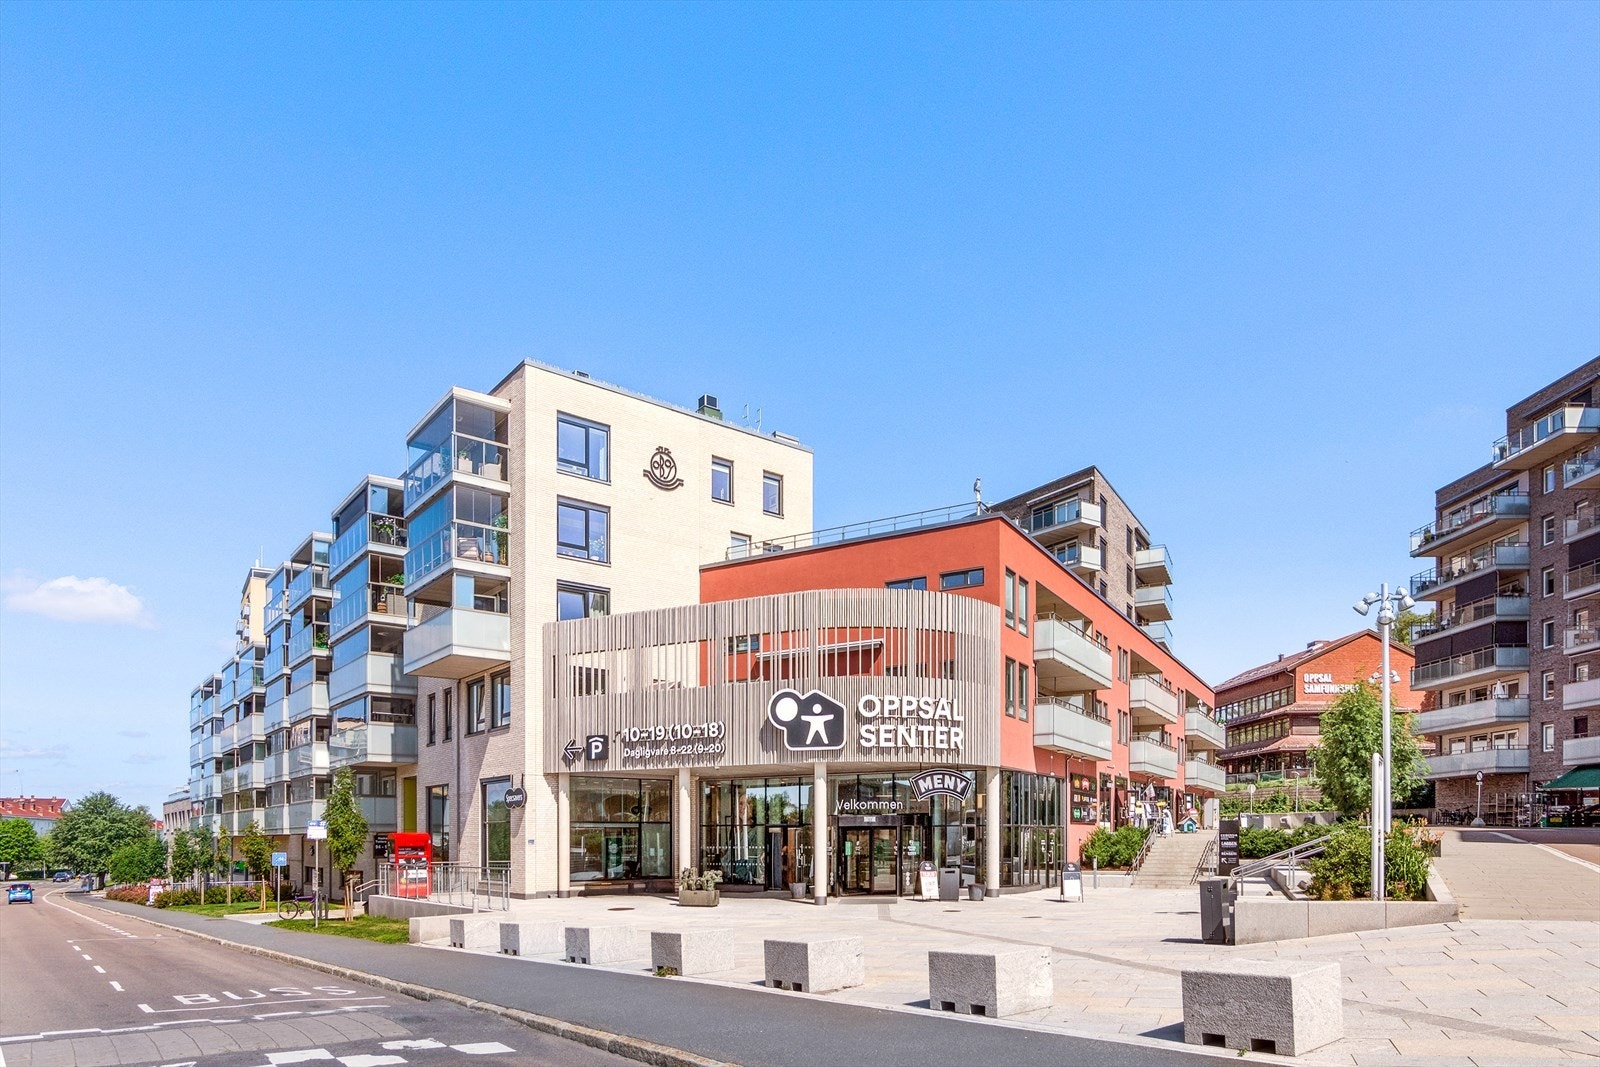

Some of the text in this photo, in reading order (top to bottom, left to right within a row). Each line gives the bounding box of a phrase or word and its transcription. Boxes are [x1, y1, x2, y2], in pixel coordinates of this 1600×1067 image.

[1304, 673, 1332, 683] OPPSAL
[858, 694, 964, 721] OPPSAL
[860, 724, 964, 750] SENTER
[591, 741, 602, 759] P
[624, 747, 668, 759] Dagligvare
[919, 775, 967, 793] MENY
[836, 799, 903, 811] Velkommen
[173, 984, 356, 1005] BUSS
